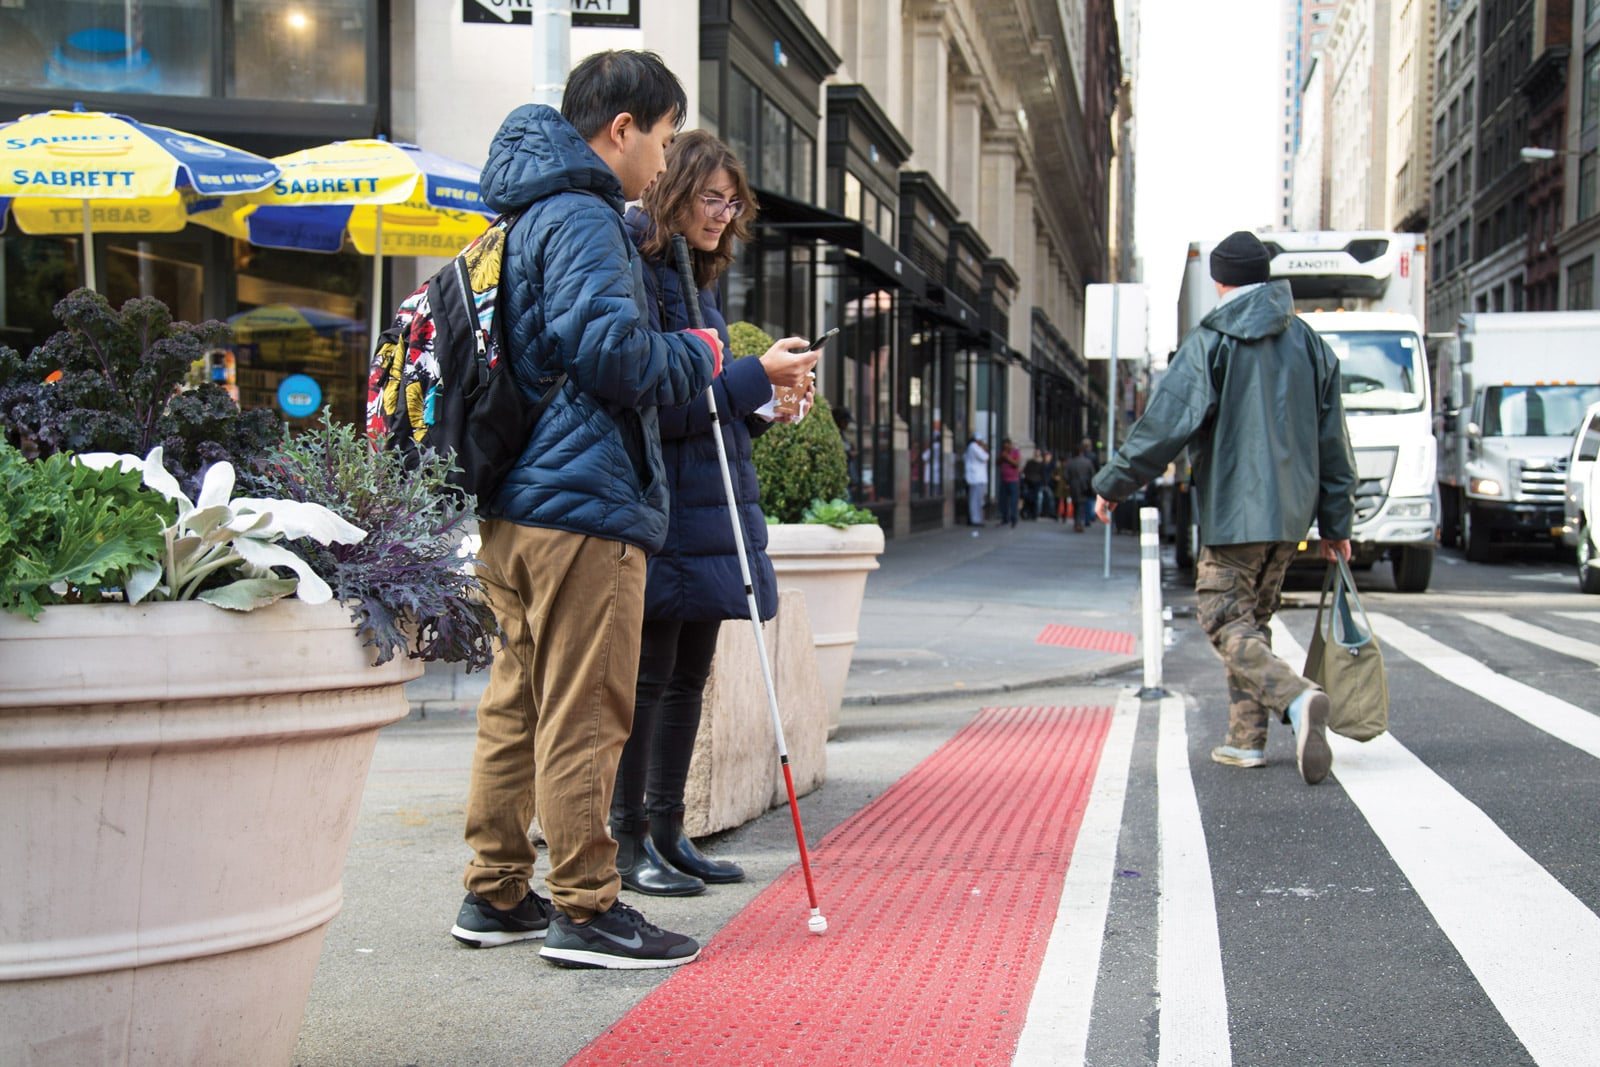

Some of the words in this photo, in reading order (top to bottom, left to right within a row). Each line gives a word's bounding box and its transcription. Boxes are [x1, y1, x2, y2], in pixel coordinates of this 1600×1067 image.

[13, 169, 135, 187] SABRETT
[274, 177, 379, 196] SABRETT
[1288, 260, 1339, 270] ZANOTTI
